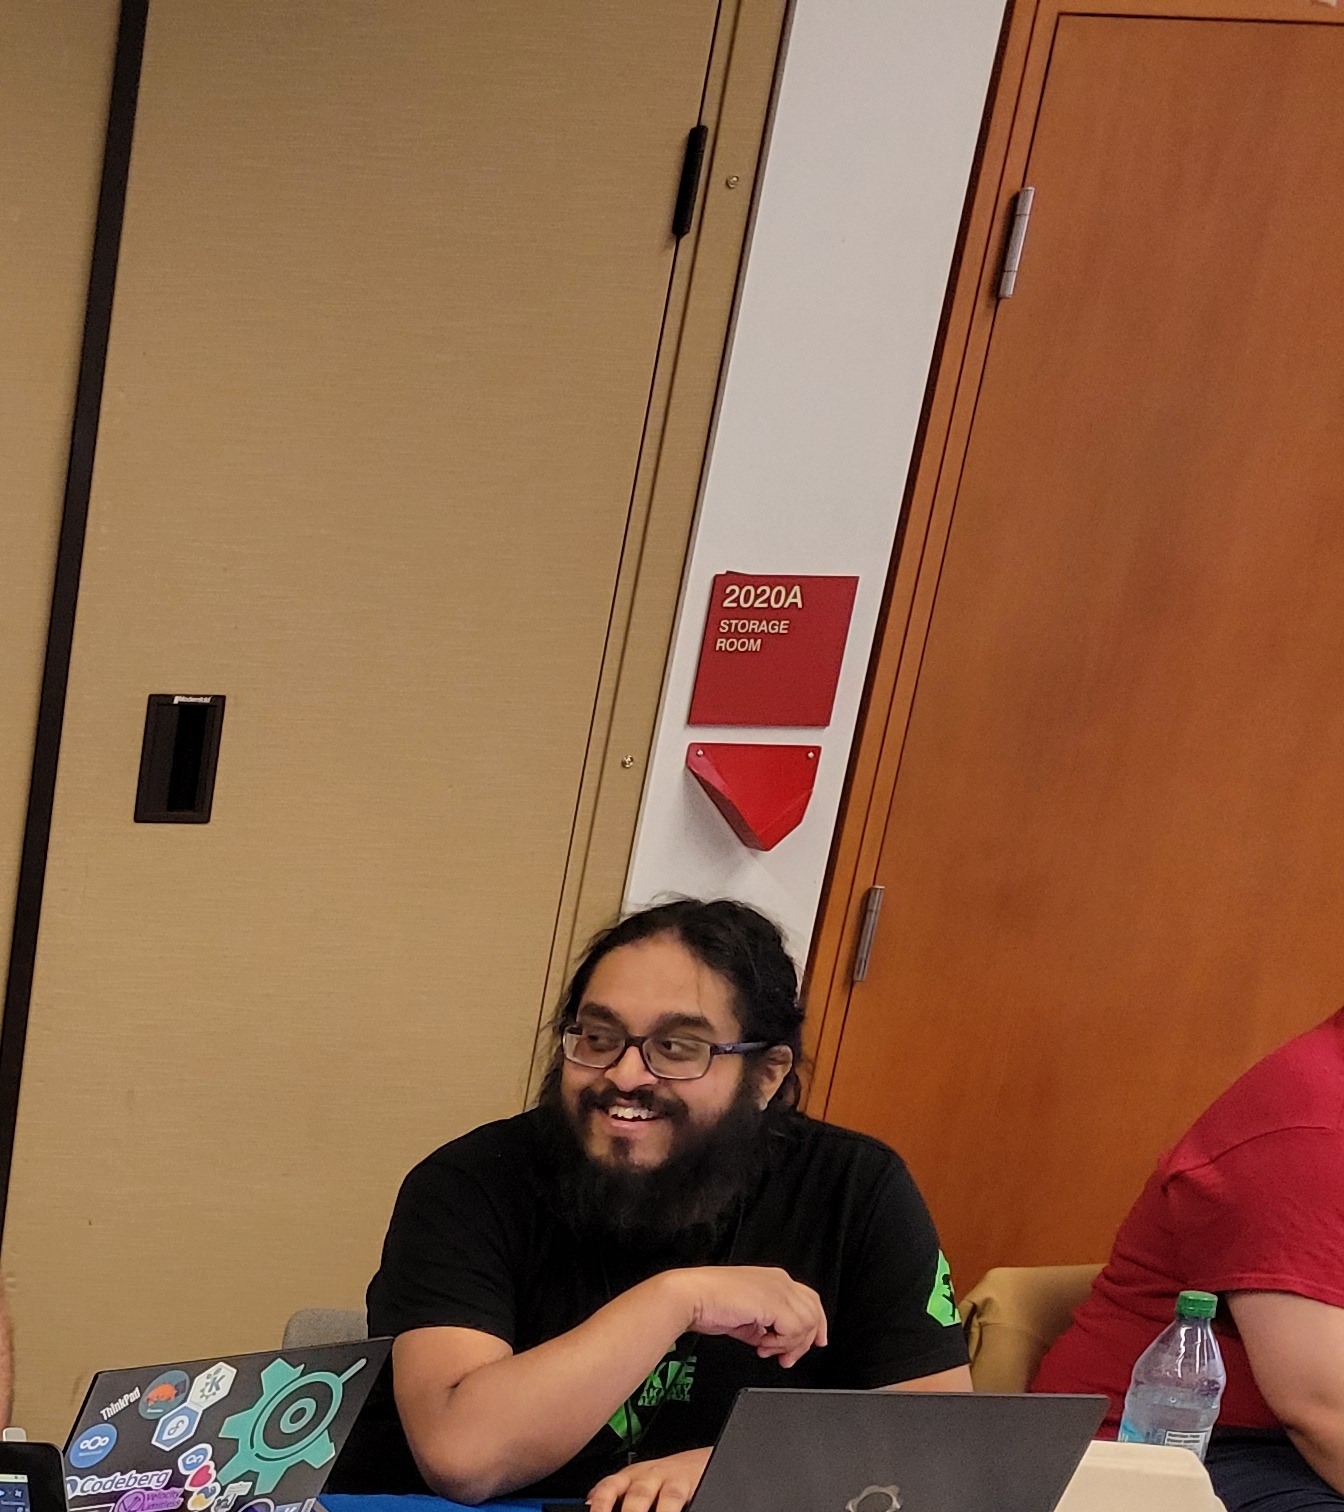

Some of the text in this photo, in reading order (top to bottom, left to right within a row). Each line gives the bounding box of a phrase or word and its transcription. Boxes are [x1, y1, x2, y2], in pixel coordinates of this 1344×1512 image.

[722, 585, 803, 609] 2020A
[719, 619, 790, 634] STORAGE
[715, 638, 762, 652] ROOM
[100, 1386, 142, 1421] ThinkPad
[80, 1472, 169, 1494] Codeberg
